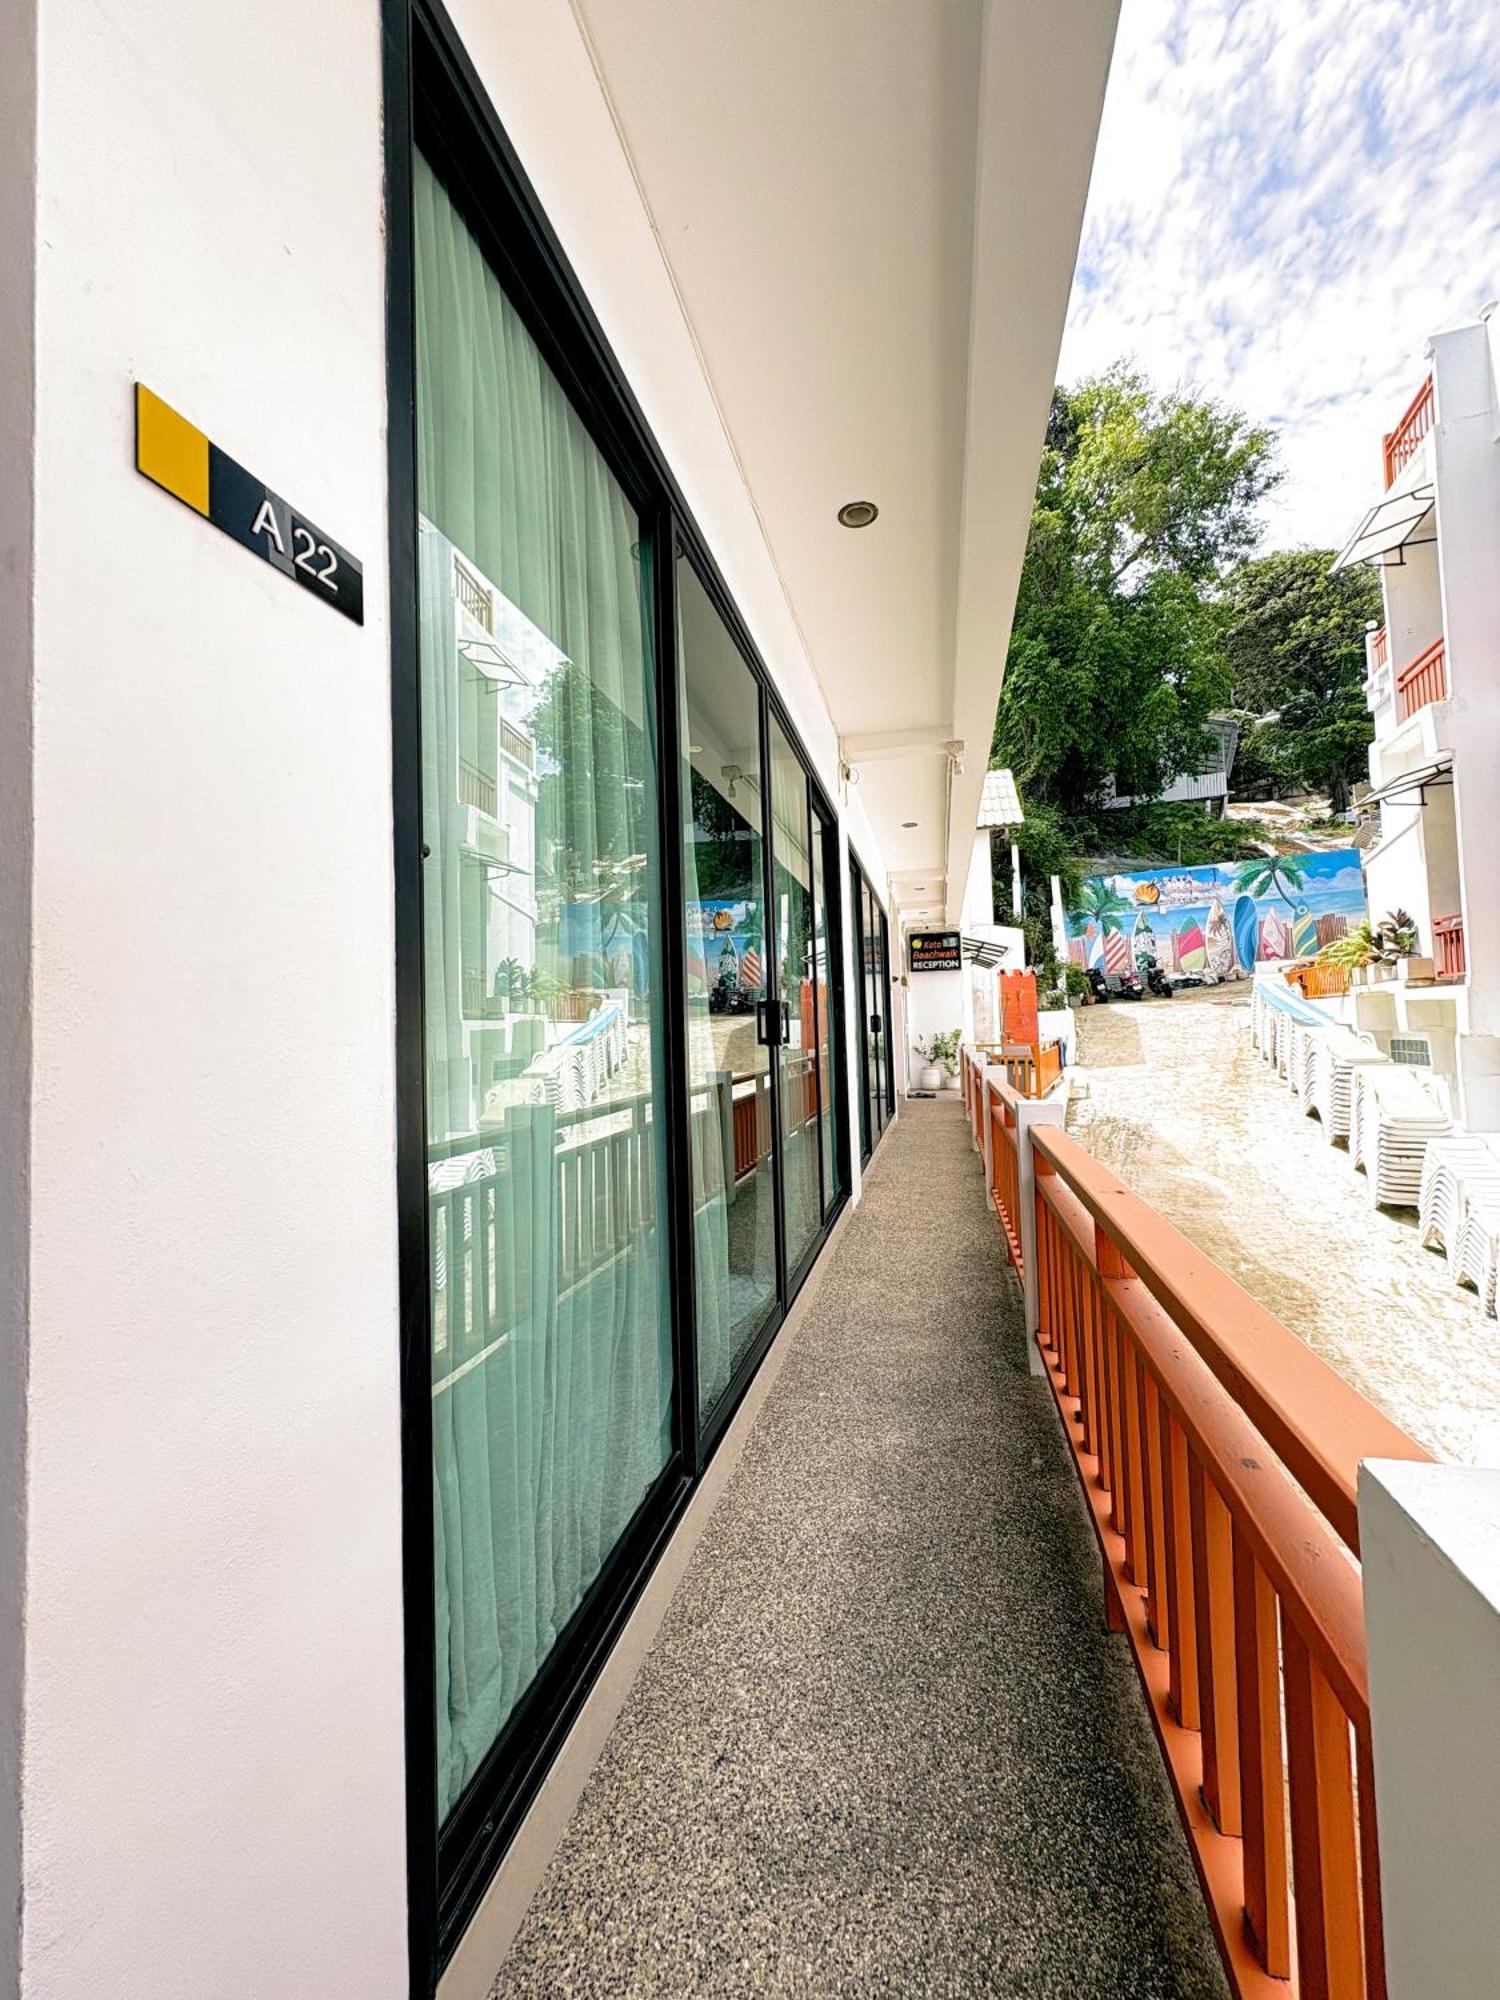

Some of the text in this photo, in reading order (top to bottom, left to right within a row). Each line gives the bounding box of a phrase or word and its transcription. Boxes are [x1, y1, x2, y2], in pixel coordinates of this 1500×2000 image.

[251, 499, 338, 591] A 22
[913, 960, 959, 969] RECEPTION
